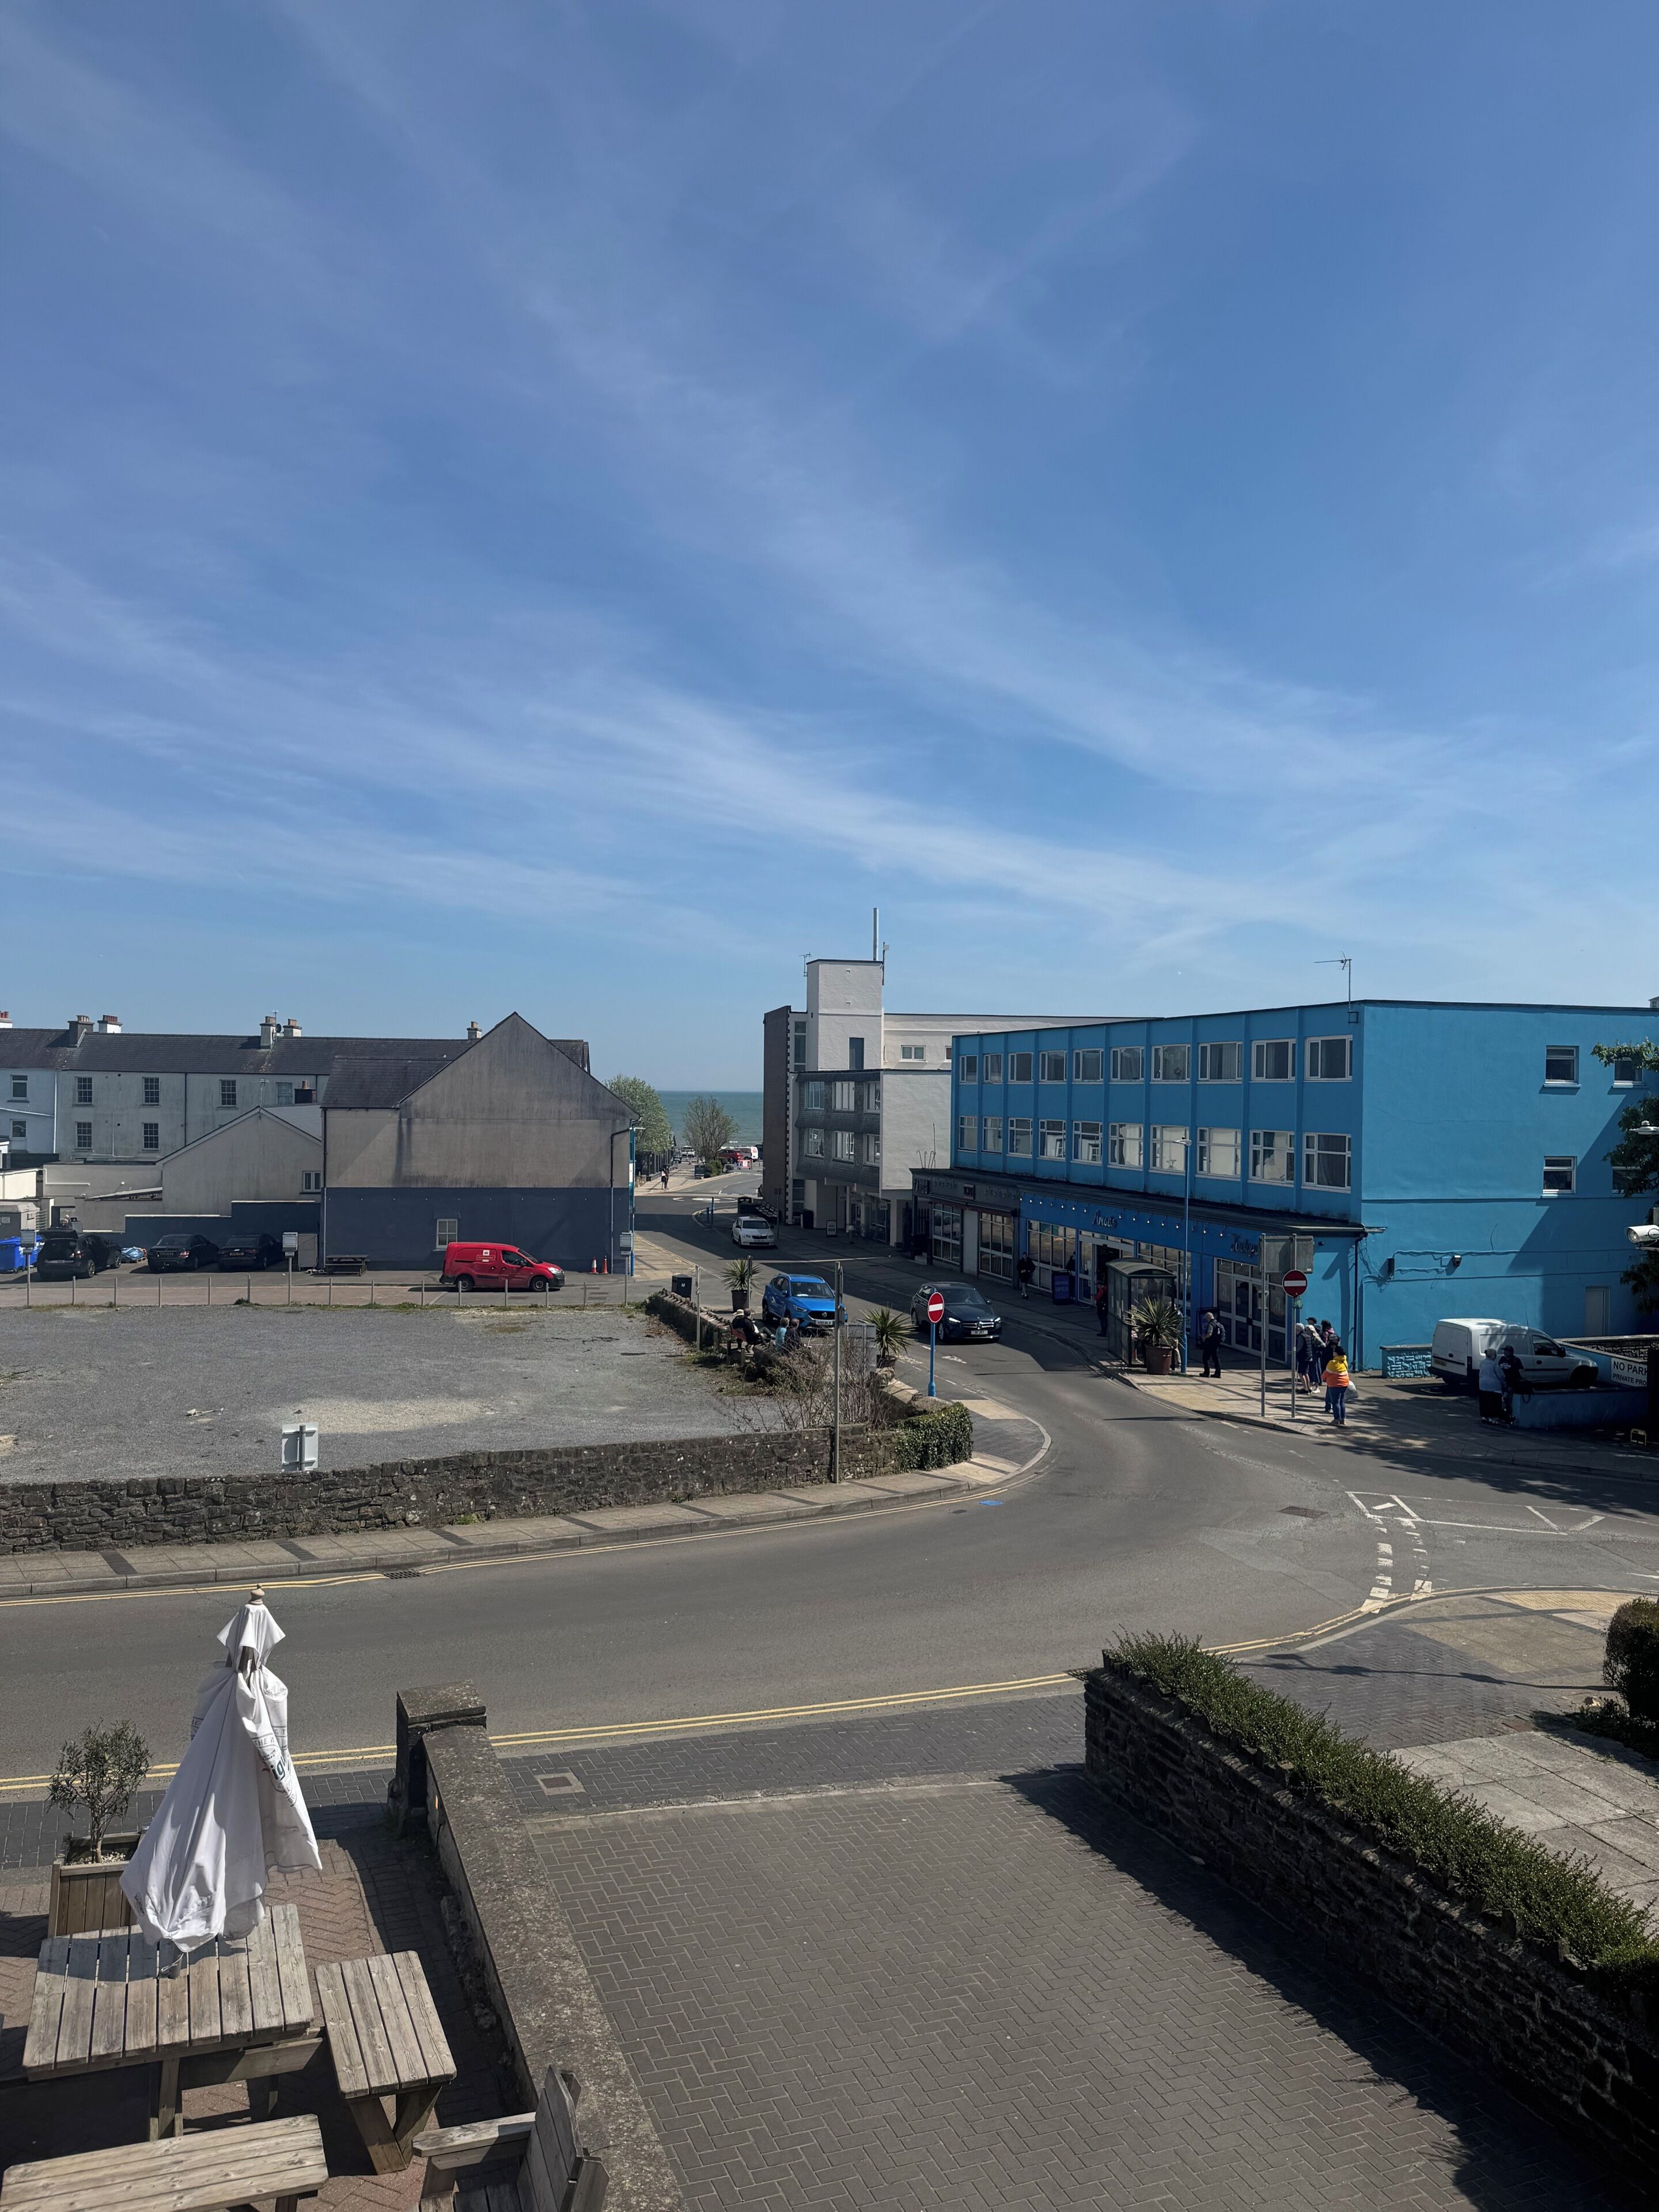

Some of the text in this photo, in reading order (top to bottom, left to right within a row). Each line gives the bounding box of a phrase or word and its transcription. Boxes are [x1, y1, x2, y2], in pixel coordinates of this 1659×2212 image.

[1613, 1361, 1624, 1370] NO
[1613, 1373, 1634, 1383] PRIVATE
[253, 1738, 267, 1746] THE
